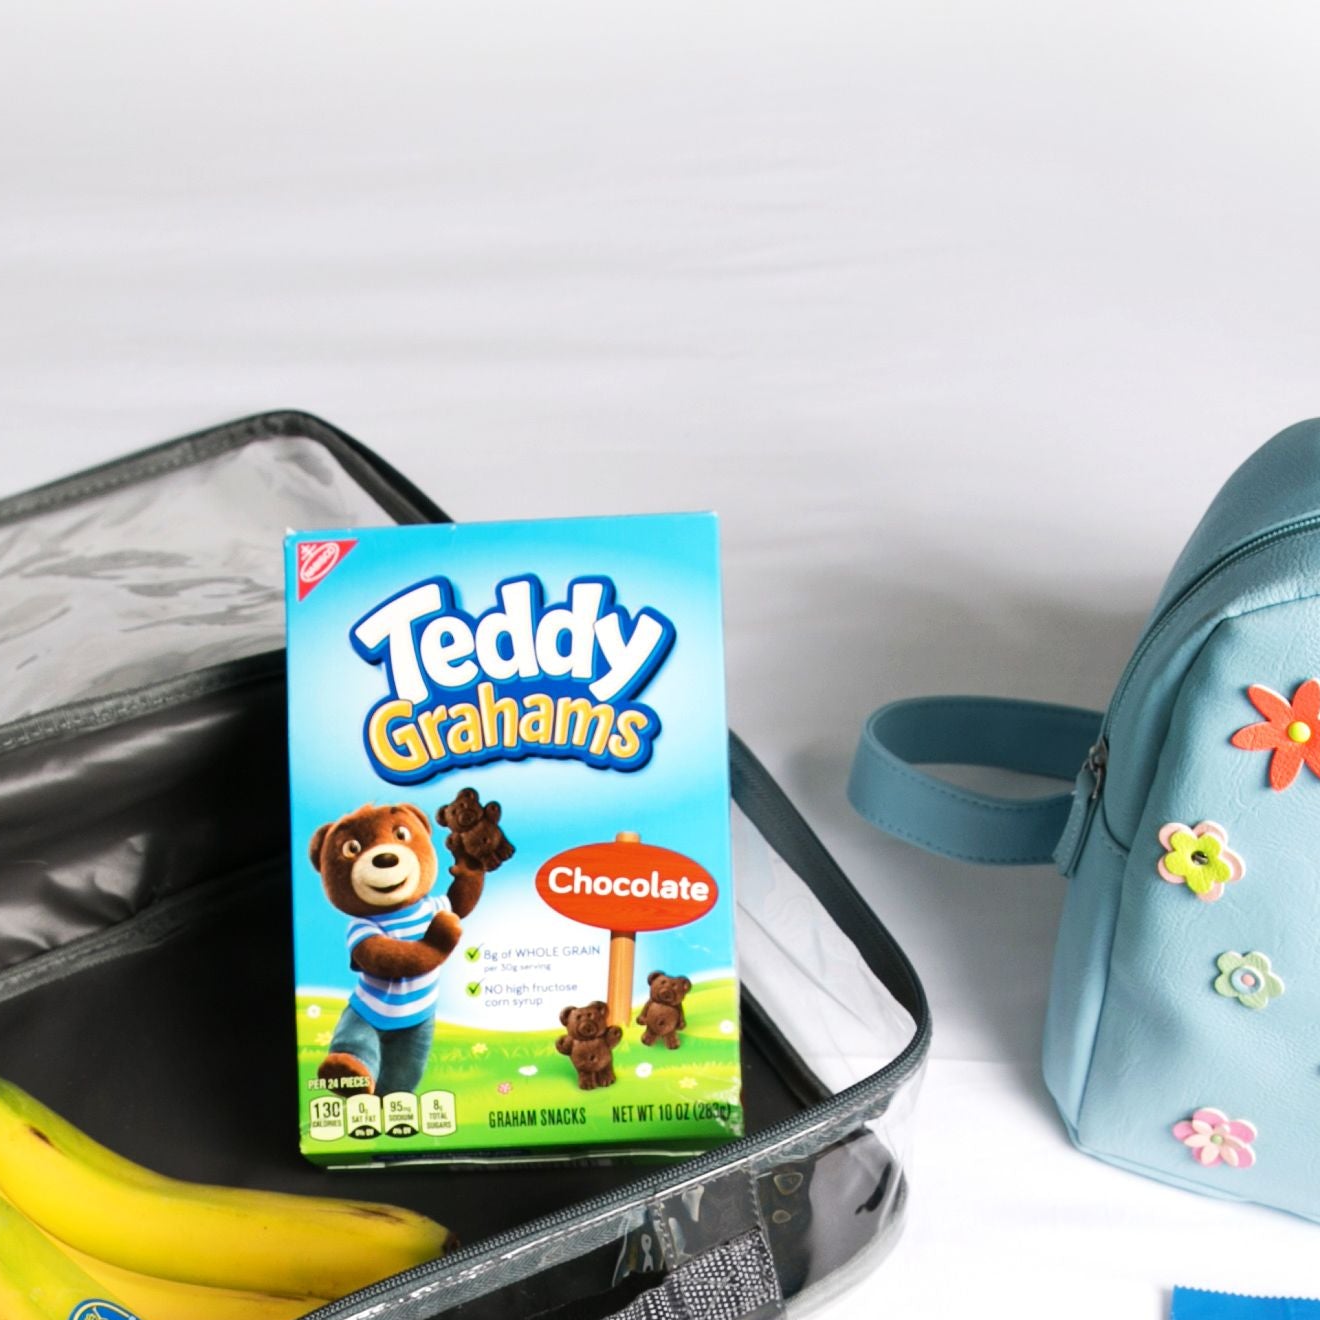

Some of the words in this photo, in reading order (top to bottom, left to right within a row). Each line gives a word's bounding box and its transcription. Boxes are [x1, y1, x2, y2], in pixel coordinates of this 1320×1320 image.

[355, 580, 663, 704] Teddy
[369, 682, 648, 771] Grahams
[548, 867, 709, 901] Chocolate
[502, 950, 512, 959] of
[515, 947, 560, 958] WHOLE
[562, 946, 600, 957] GRAIN
[484, 965, 498, 973] per
[520, 962, 551, 971] serving
[485, 985, 503, 994] NO
[506, 983, 530, 995] high
[533, 982, 578, 992] fructose
[485, 999, 509, 1007] corn
[513, 997, 543, 1007] syrup
[308, 1079, 326, 1090] PER
[328, 1078, 338, 1089] 24
[341, 1076, 370, 1088] PIECES
[313, 1102, 340, 1119] 130
[489, 1109, 537, 1128] GRAHAM
[540, 1107, 586, 1126] SNACKS
[612, 1105, 633, 1124] NET
[637, 1104, 654, 1122] WT
[659, 1104, 672, 1121] 10
[675, 1103, 690, 1120] OZ
